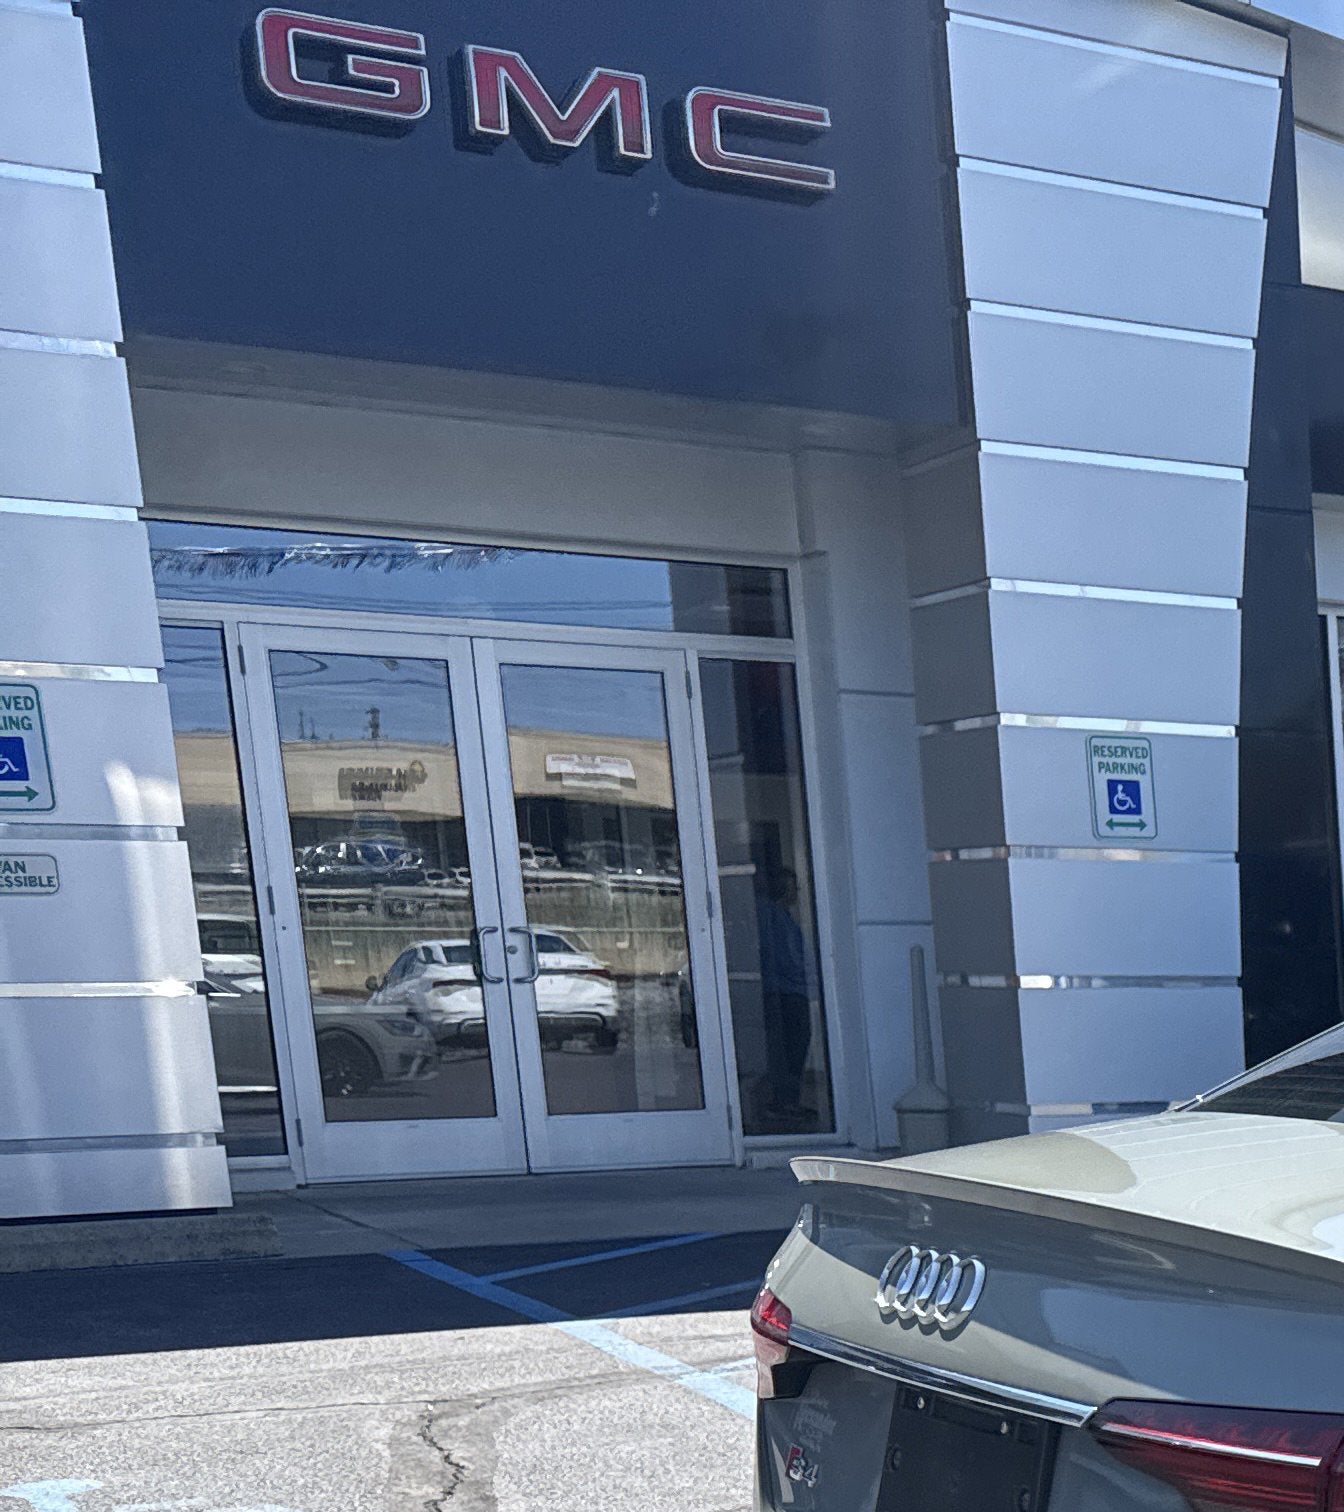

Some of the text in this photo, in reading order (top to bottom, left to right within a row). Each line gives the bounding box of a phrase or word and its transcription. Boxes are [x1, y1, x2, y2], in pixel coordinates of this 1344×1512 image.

[255, 7, 836, 190] GMC
[0, 695, 35, 711] VED
[0, 715, 33, 731] ING
[1093, 745, 1149, 759] RESERVED
[1098, 761, 1146, 775] PARKING
[0, 860, 27, 874] AN
